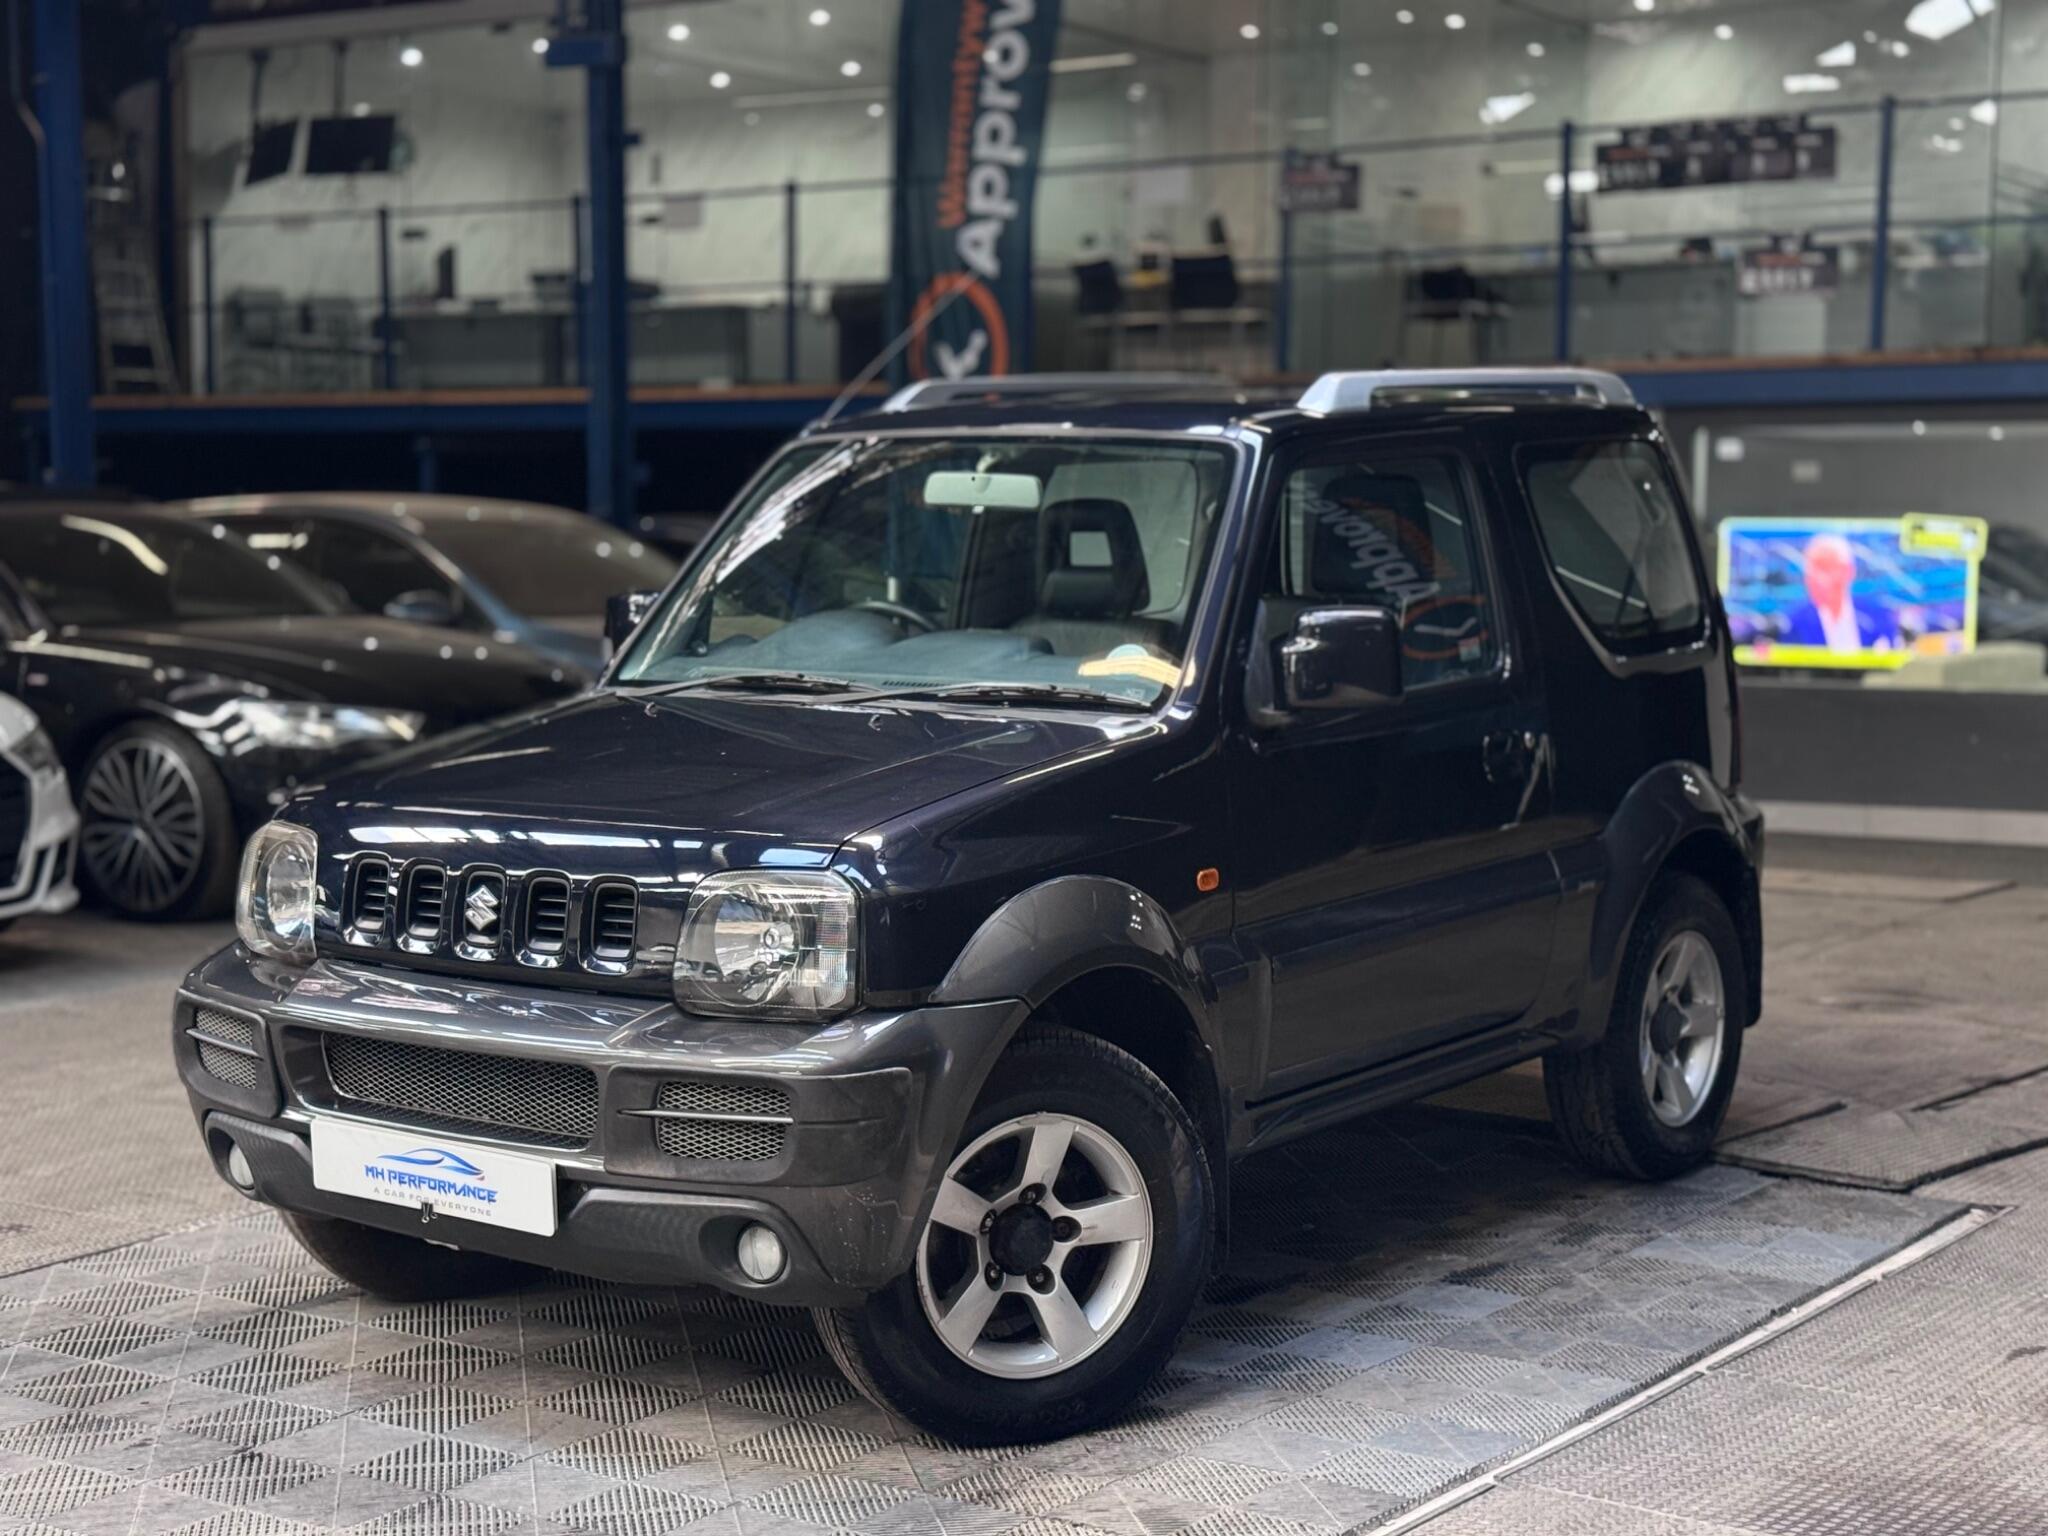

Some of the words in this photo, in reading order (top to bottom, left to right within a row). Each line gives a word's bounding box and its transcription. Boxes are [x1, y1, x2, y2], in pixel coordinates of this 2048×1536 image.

[365, 1165, 385, 1181] MH
[387, 1168, 497, 1203] PERFORMANCE
[373, 1186, 380, 1194] A
[384, 1188, 406, 1200] CAR
[409, 1193, 430, 1204] FOR
[435, 1198, 492, 1217] EVERYONE
